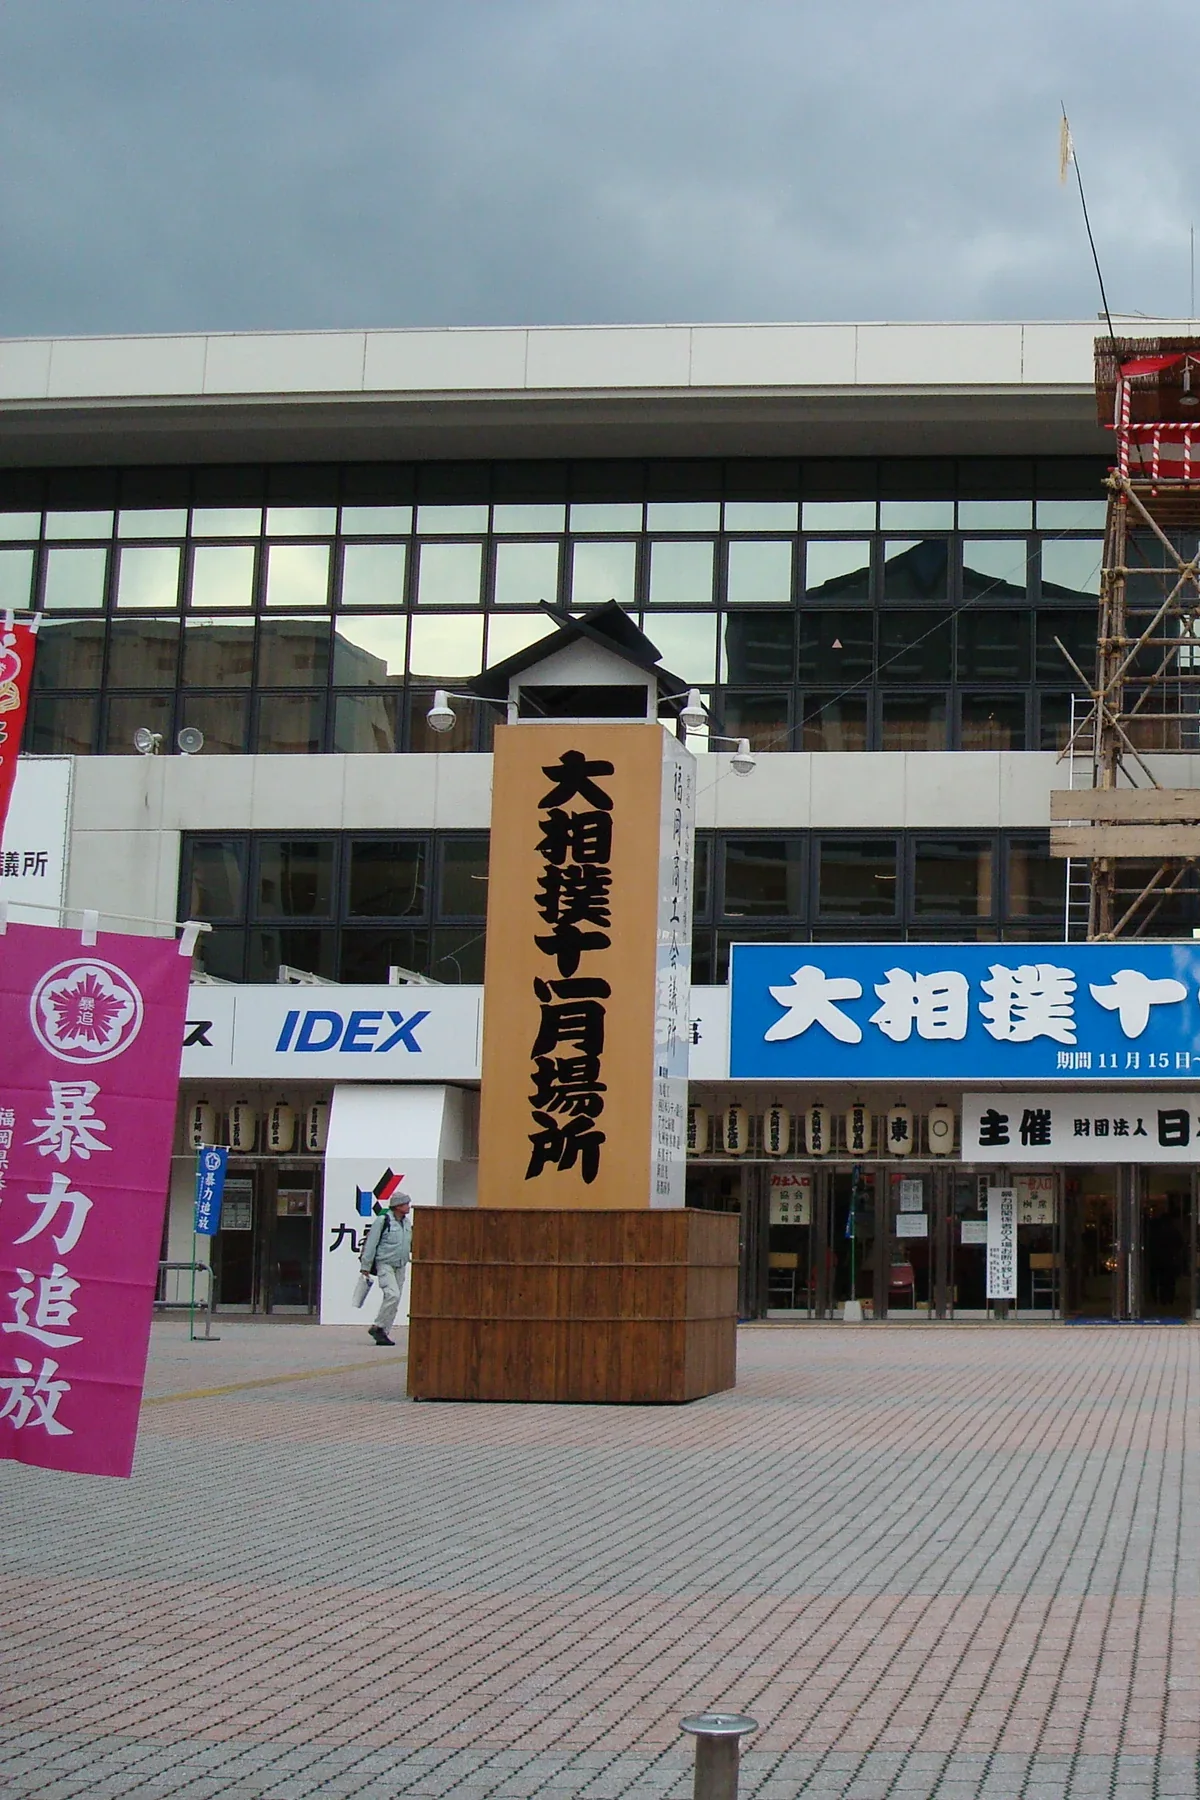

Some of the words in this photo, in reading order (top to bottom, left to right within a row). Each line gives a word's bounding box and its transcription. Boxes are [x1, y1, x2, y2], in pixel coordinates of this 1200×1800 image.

[525, 750, 615, 1185] 大相撲十一月場所
[275, 1010, 432, 1053] IDEX
[891, 1117, 909, 1142] 東
[978, 1109, 1053, 1146] 主催
[1073, 1118, 1149, 1137] 財団法人
[770, 1174, 811, 1188] 力士入口
[0, 1079, 113, 1436] 暴力追放
